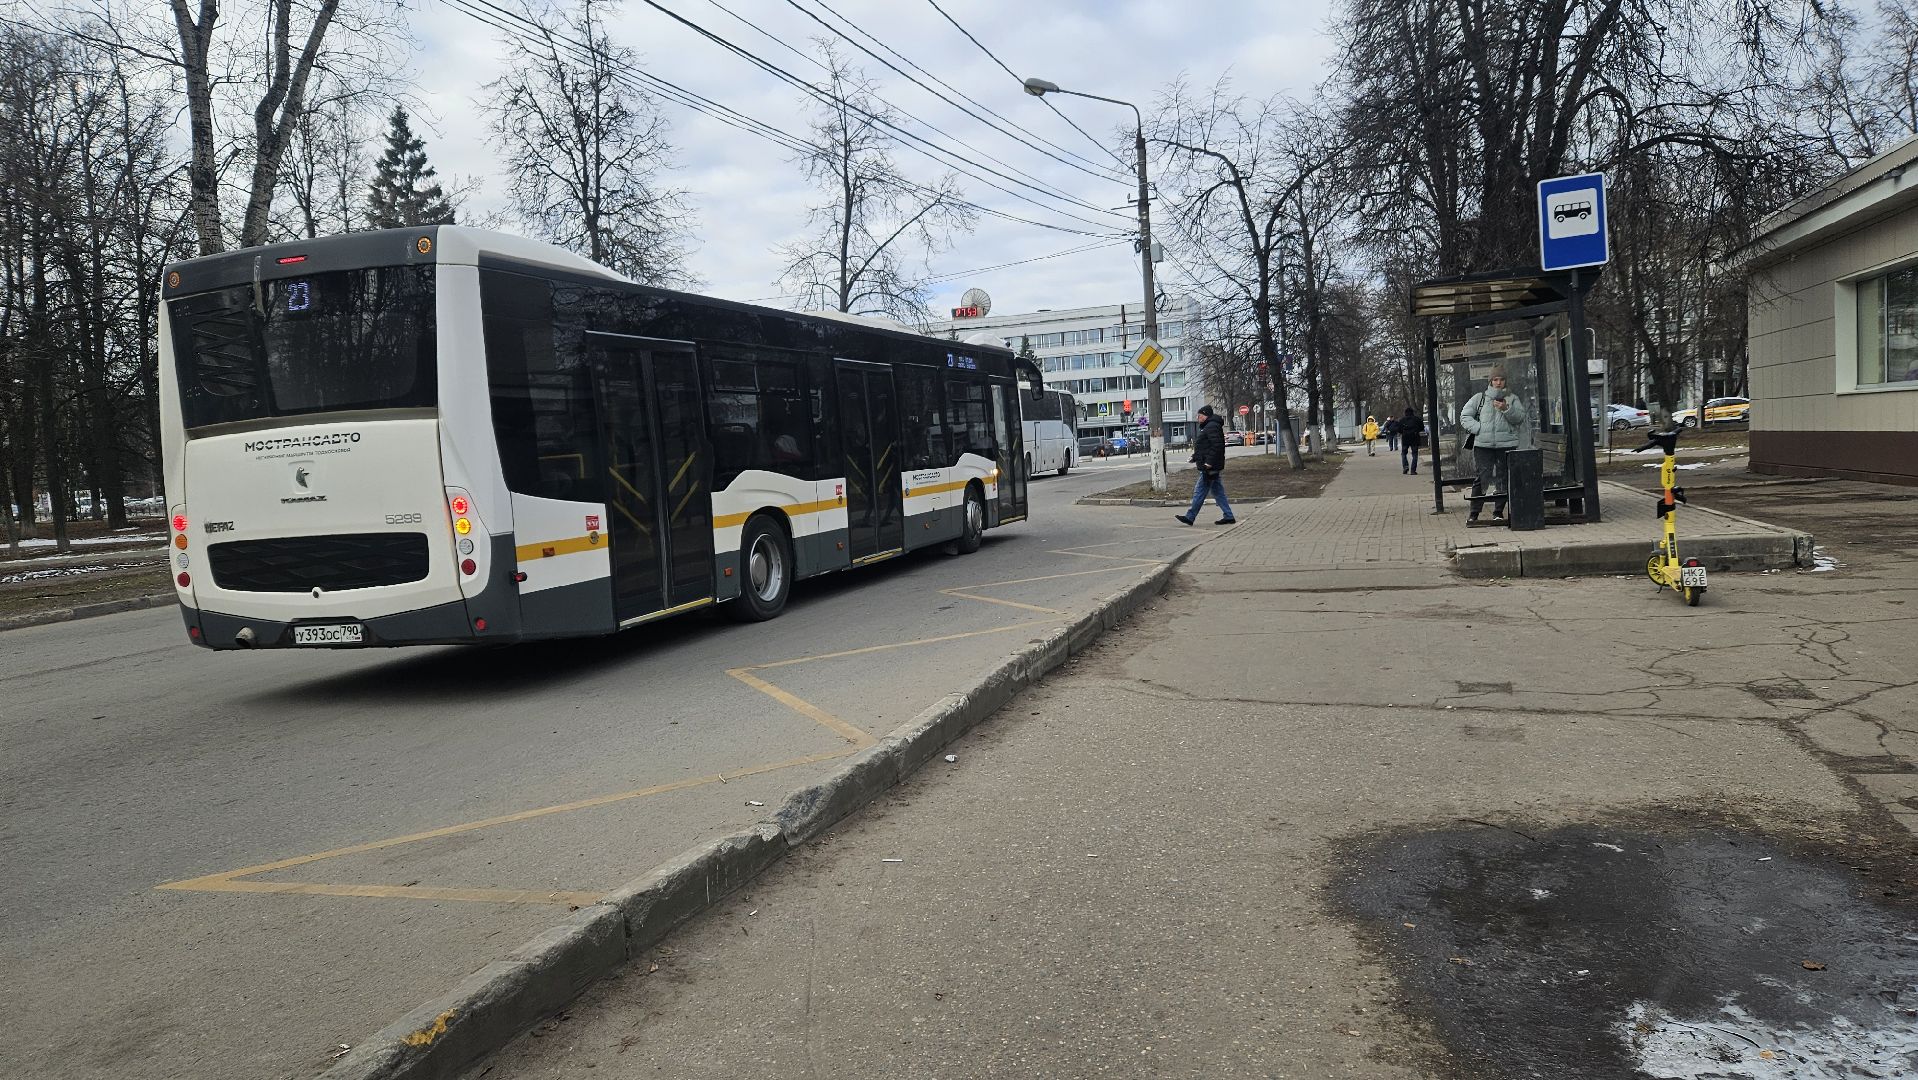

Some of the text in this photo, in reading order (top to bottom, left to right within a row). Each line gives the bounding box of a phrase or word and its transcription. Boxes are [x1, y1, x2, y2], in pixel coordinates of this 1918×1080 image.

[288, 282, 309, 311] 23
[245, 432, 361, 452] МОСТРАНСАВТО
[385, 513, 422, 525] 5299
